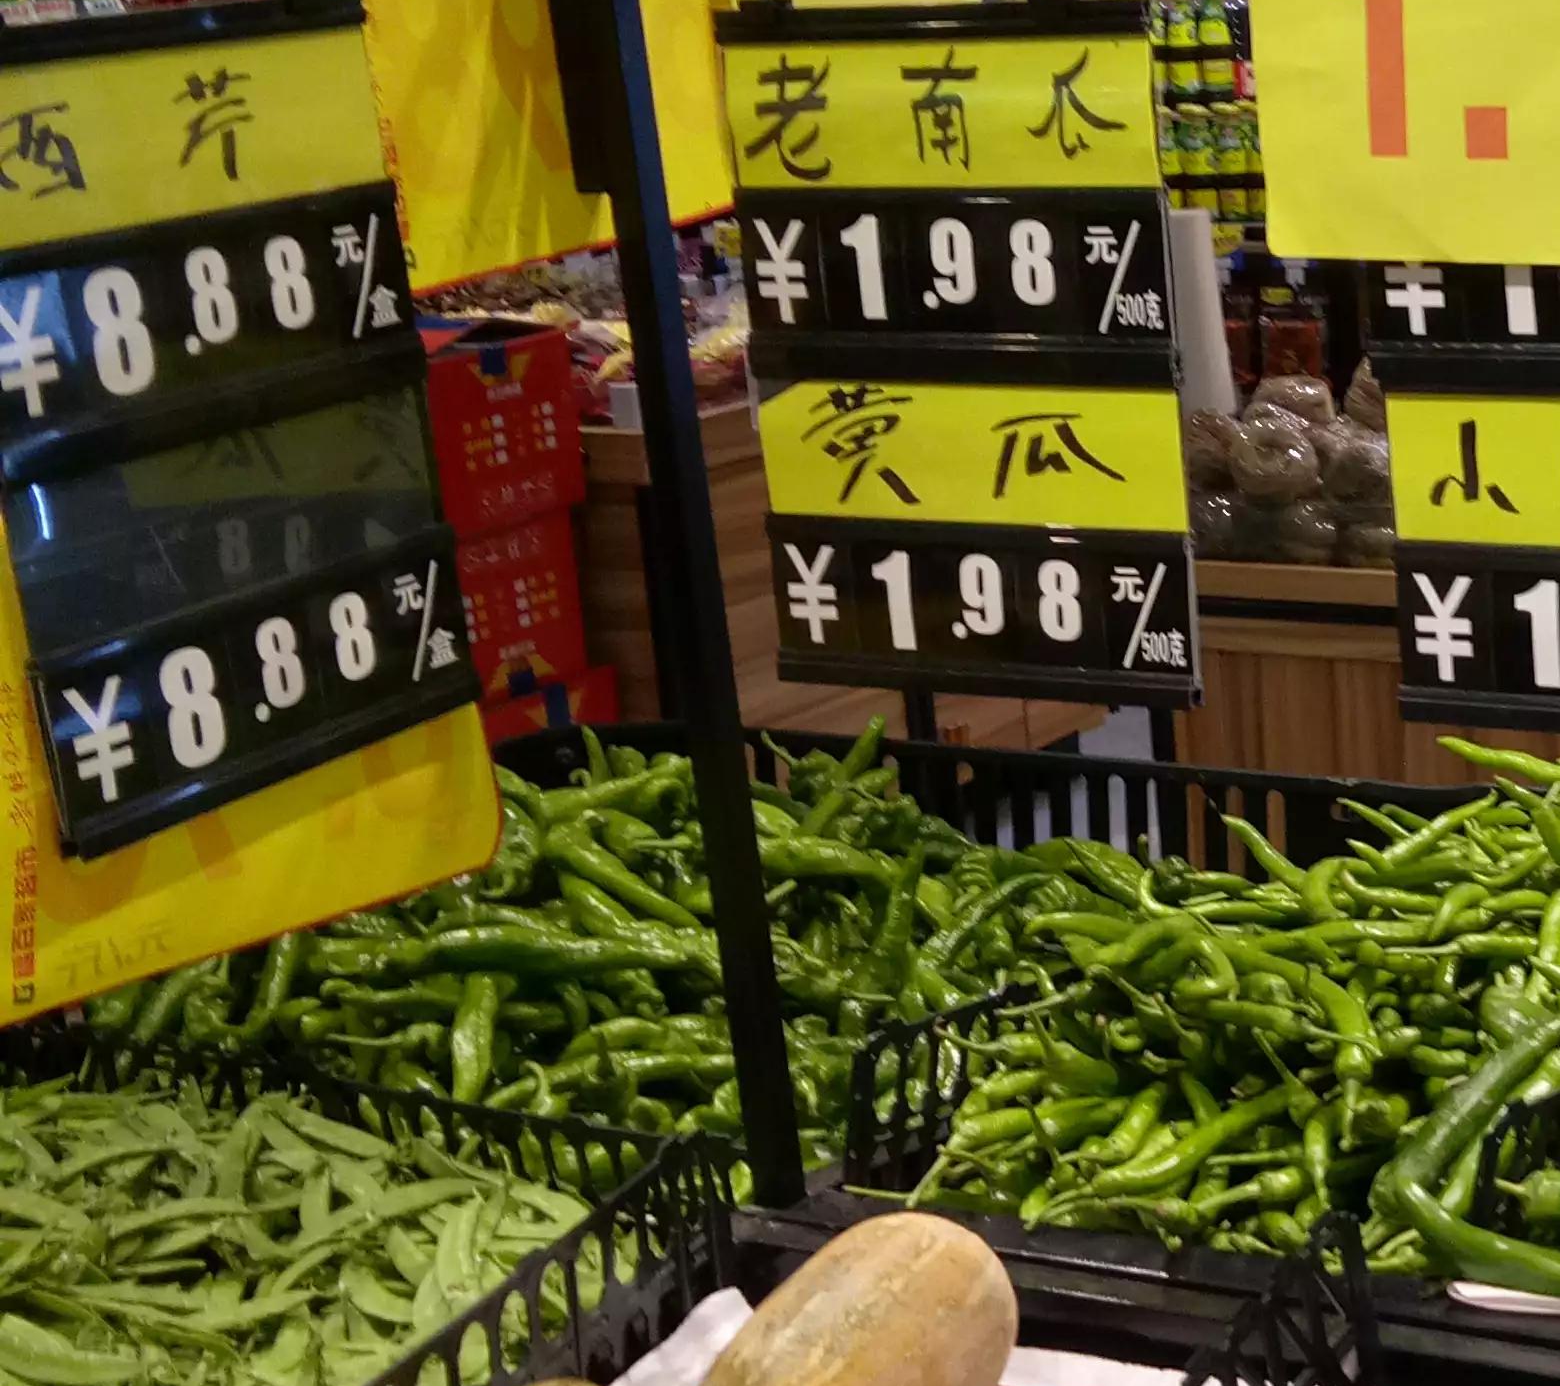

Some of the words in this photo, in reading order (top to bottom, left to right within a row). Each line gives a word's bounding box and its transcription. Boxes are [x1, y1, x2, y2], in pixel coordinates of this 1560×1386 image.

[744, 46, 1128, 181] 老南瓜
[800, 382, 1127, 504] 黄瓜
